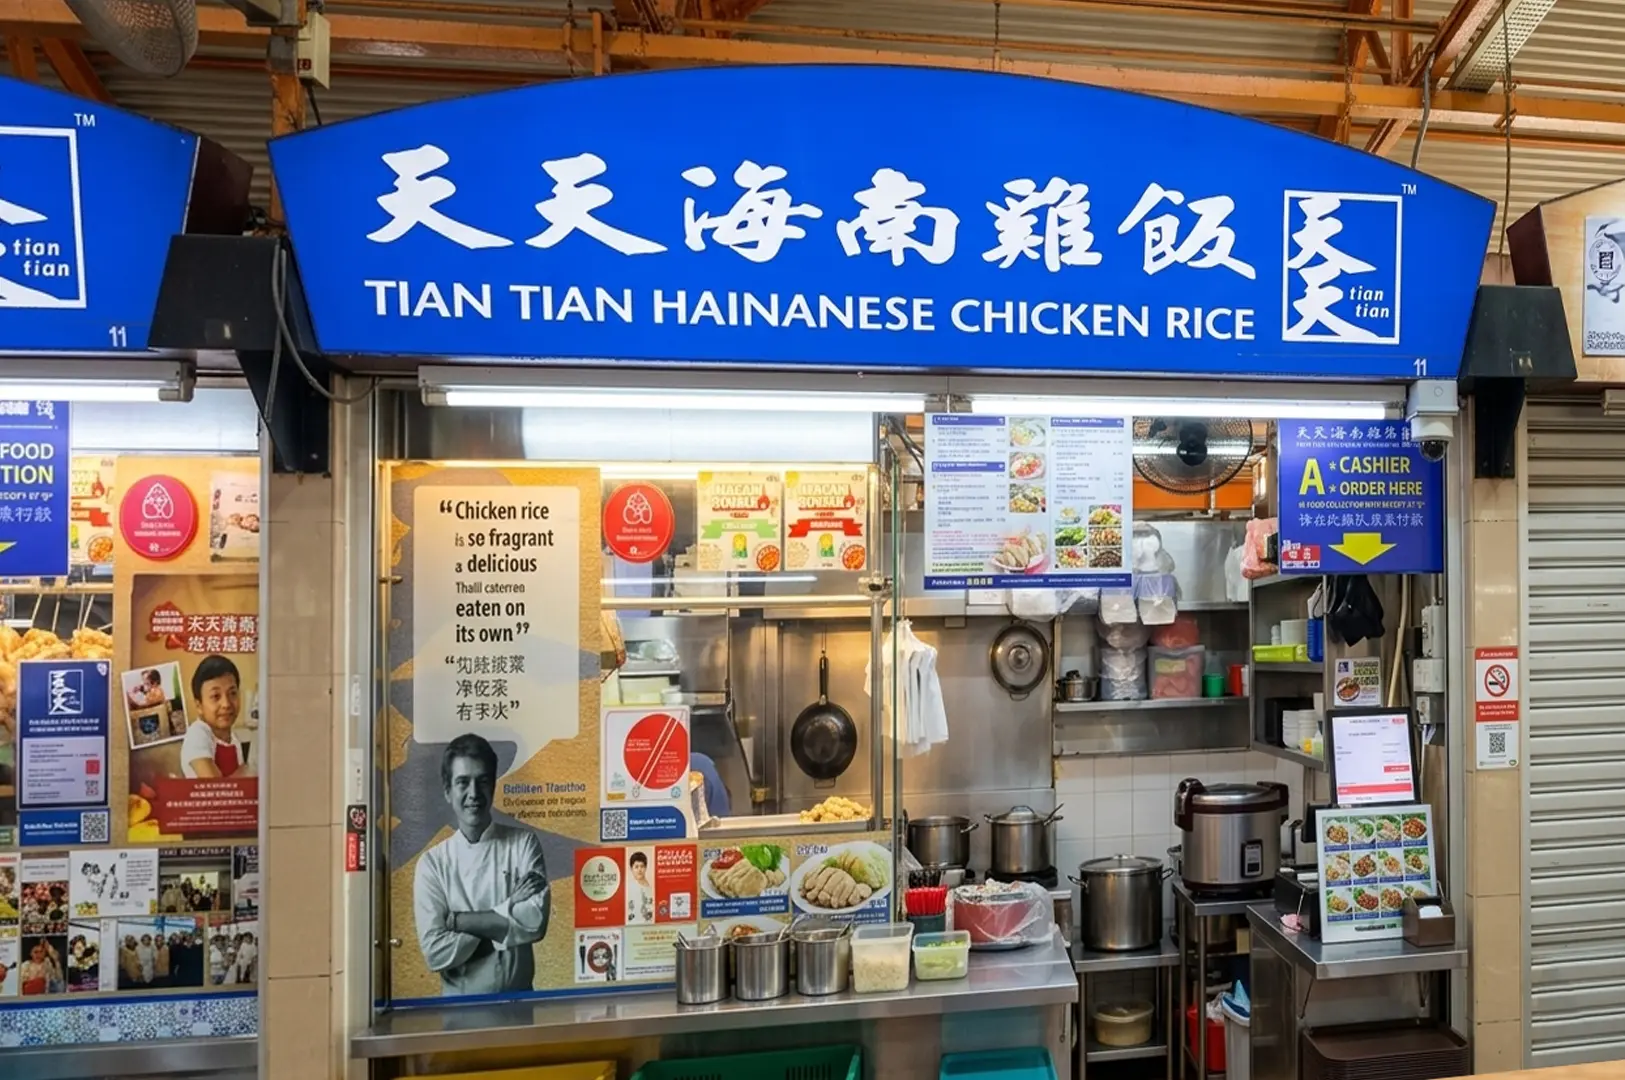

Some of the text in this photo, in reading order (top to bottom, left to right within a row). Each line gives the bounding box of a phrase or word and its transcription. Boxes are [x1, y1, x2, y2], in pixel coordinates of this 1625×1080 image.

[74, 113, 96, 127] TM
[1402, 183, 1417, 195] TM
[13, 238, 60, 256] tian
[23, 260, 70, 276] tian
[1350, 285, 1384, 301] tian
[364, 280, 1255, 340] TIAN TIAN HAINANESE CHICKEN RICE
[1355, 303, 1390, 318] tian
[109, 326, 127, 347] 11
[1414, 358, 1427, 376] 11
[0, 442, 54, 460] FOOD
[1339, 456, 1410, 473] CASHIER
[1299, 457, 1326, 495] A
[1339, 481, 1422, 495] ORDER HERE
[521, 501, 550, 520] rice
[488, 527, 554, 552] fragrant
[454, 553, 538, 574] a delicious
[455, 600, 525, 617] eaten on
[455, 623, 476, 643] its
